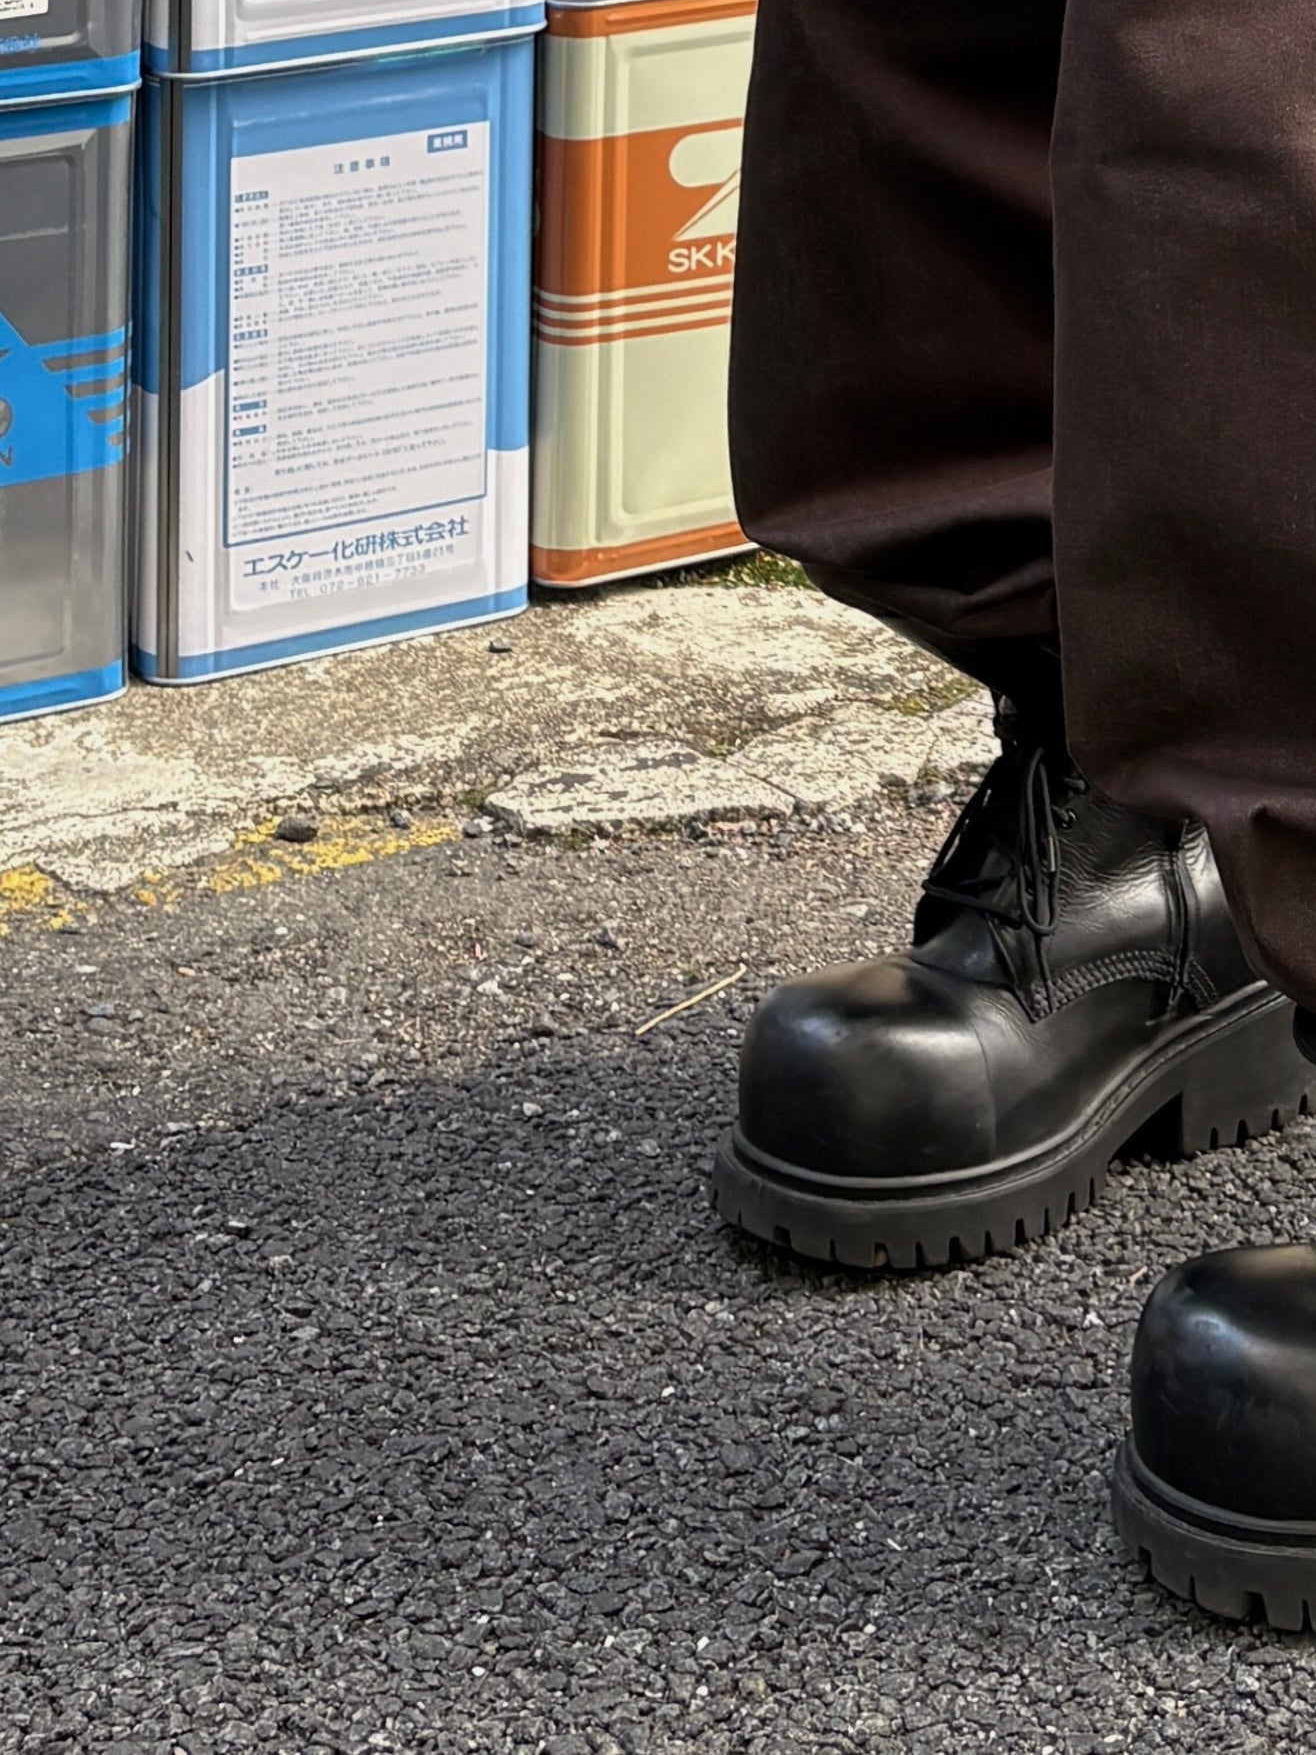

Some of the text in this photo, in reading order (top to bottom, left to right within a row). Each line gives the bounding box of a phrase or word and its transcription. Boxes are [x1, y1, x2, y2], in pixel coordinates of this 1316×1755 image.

[243, 515, 469, 578] エスケー化研株式会社
